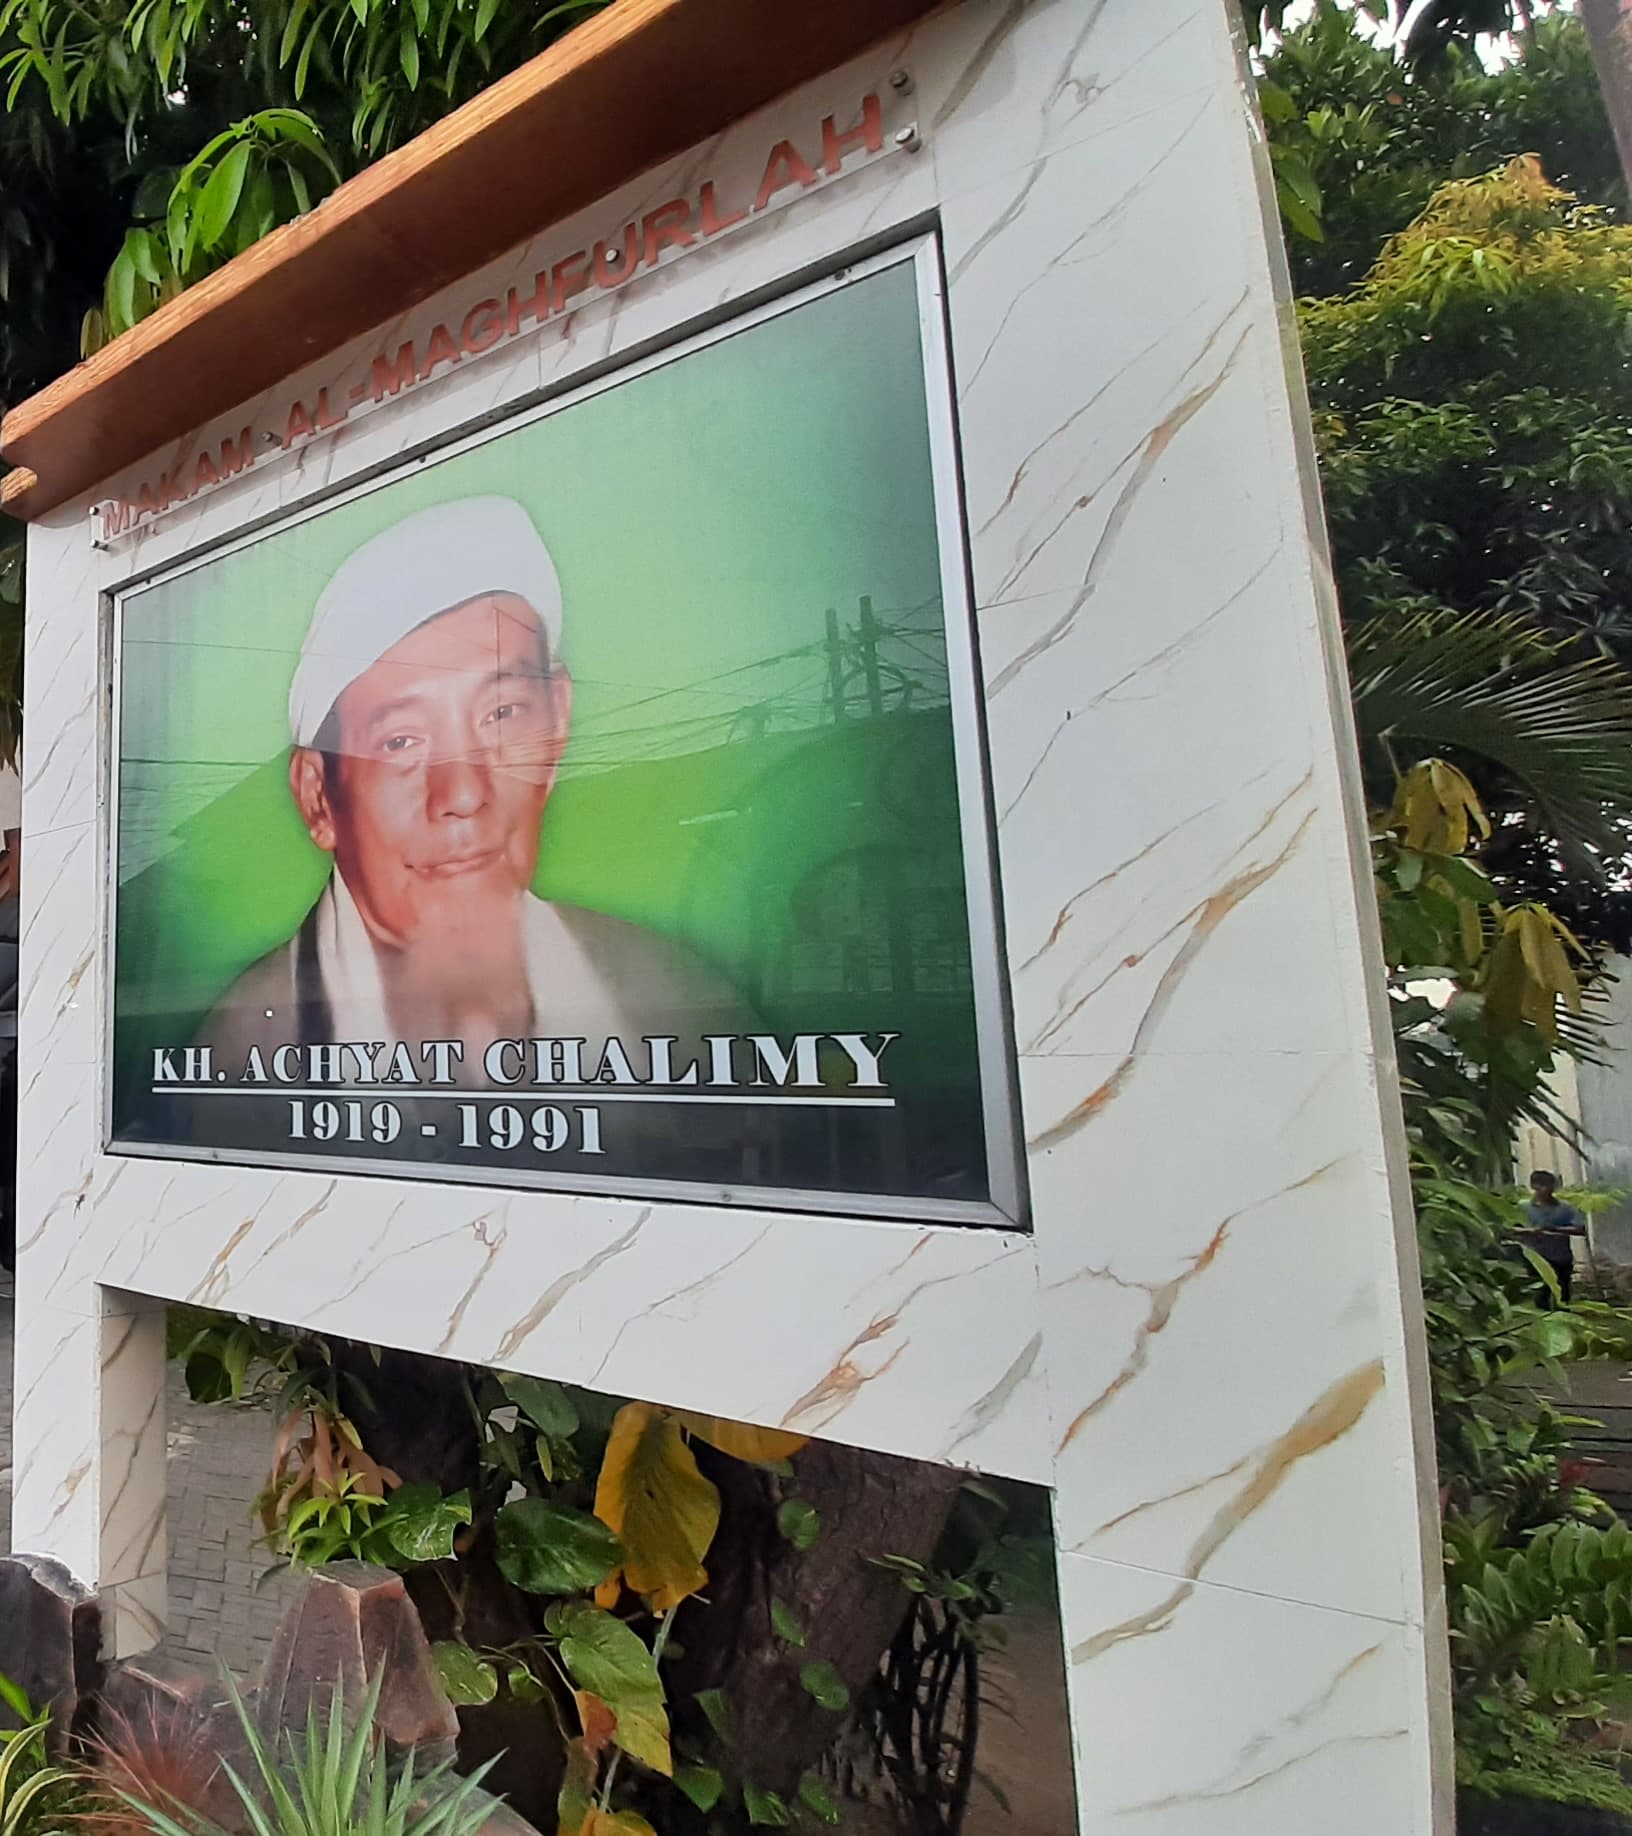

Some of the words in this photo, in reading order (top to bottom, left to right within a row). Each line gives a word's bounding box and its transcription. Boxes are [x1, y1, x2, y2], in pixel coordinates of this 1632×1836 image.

[103, 424, 256, 540] MAKAM
[280, 93, 885, 450] AL-MAGHFURLAH
[151, 1045, 228, 1083] KH.
[240, 1039, 465, 1086] ACHYAT
[482, 1031, 902, 1089] CHALIMY
[287, 1099, 402, 1144] 1919
[457, 1103, 608, 1156] 1991
